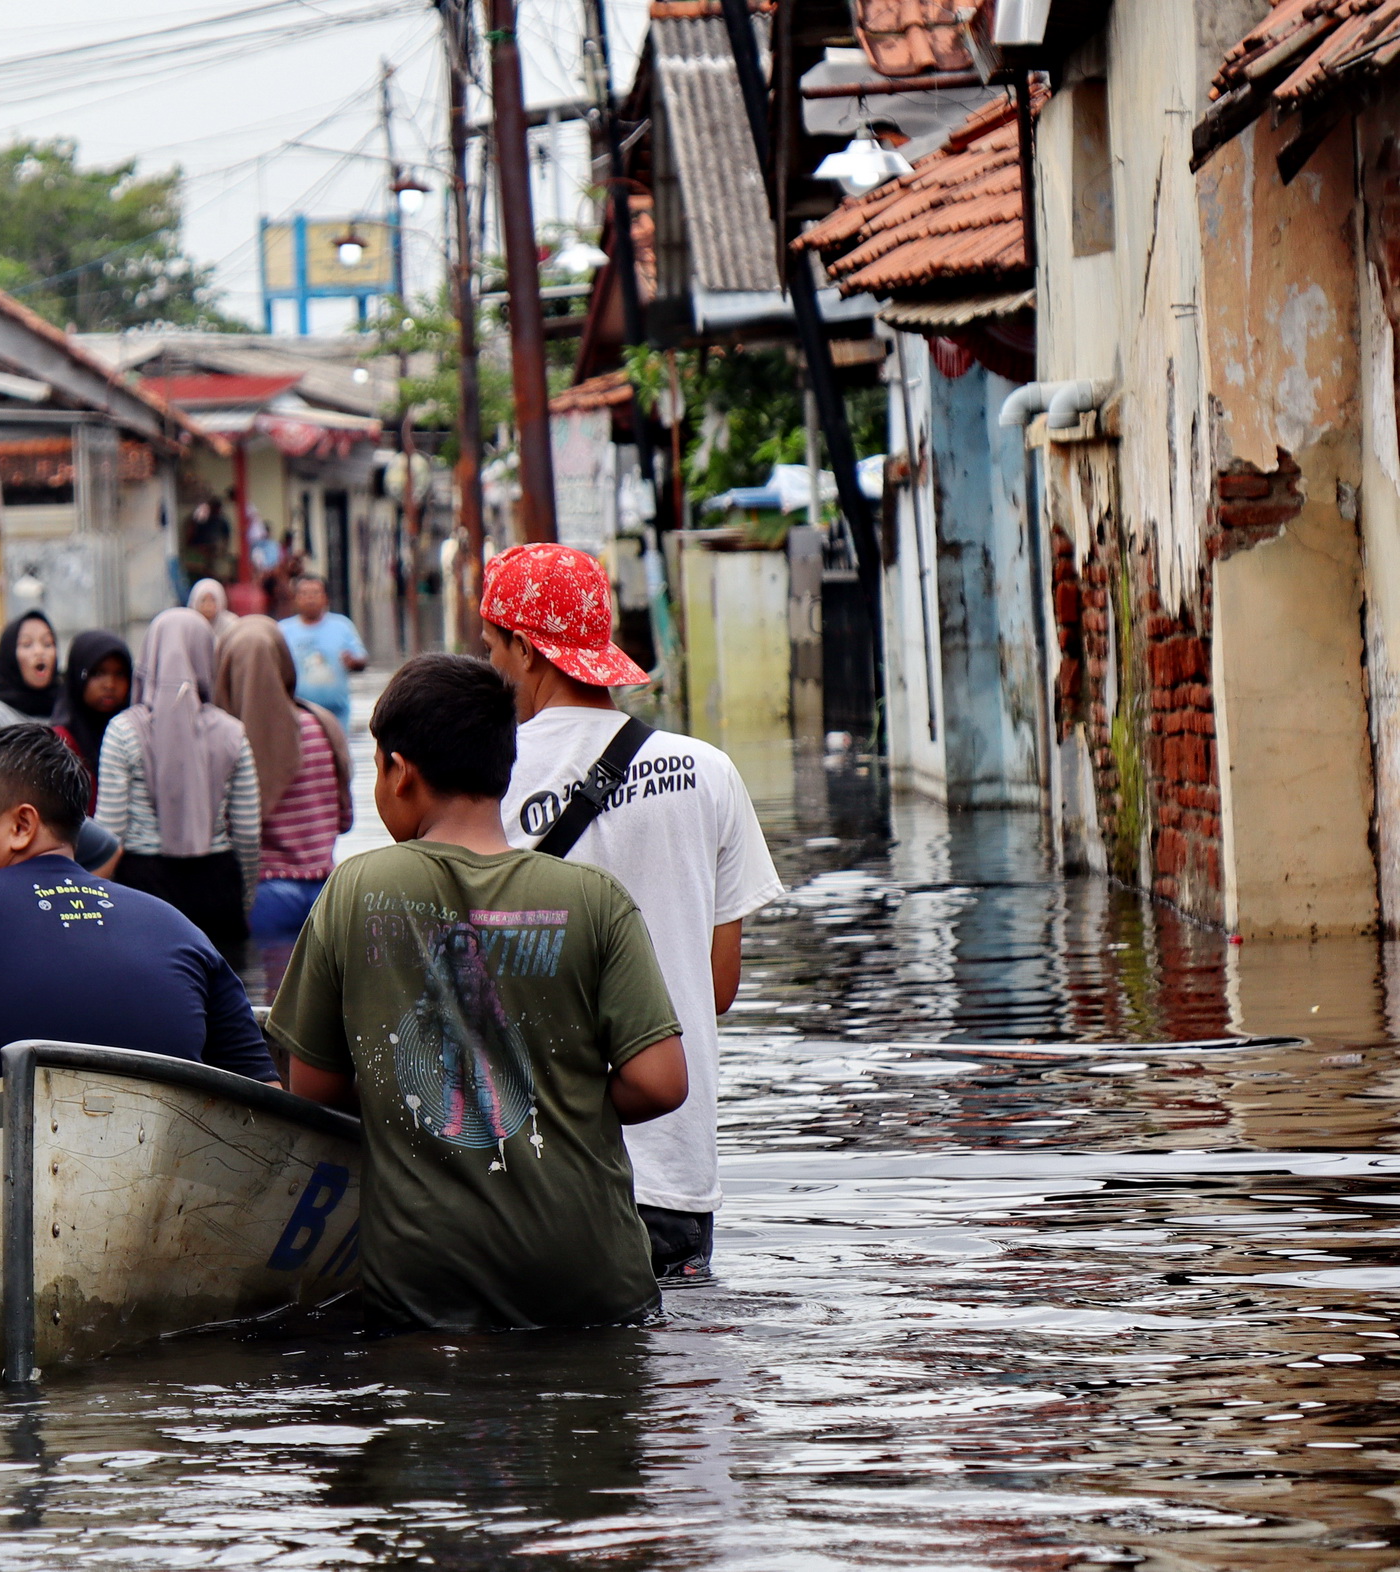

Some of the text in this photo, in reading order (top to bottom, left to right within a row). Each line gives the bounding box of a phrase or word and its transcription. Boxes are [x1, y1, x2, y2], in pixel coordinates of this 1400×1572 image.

[642, 772, 697, 799] AMIN
[526, 795, 556, 833] 01
[35, 886, 109, 898] The Best Class
[70, 899, 85, 909] VI
[363, 890, 459, 922] Universe
[489, 914, 500, 922] ME
